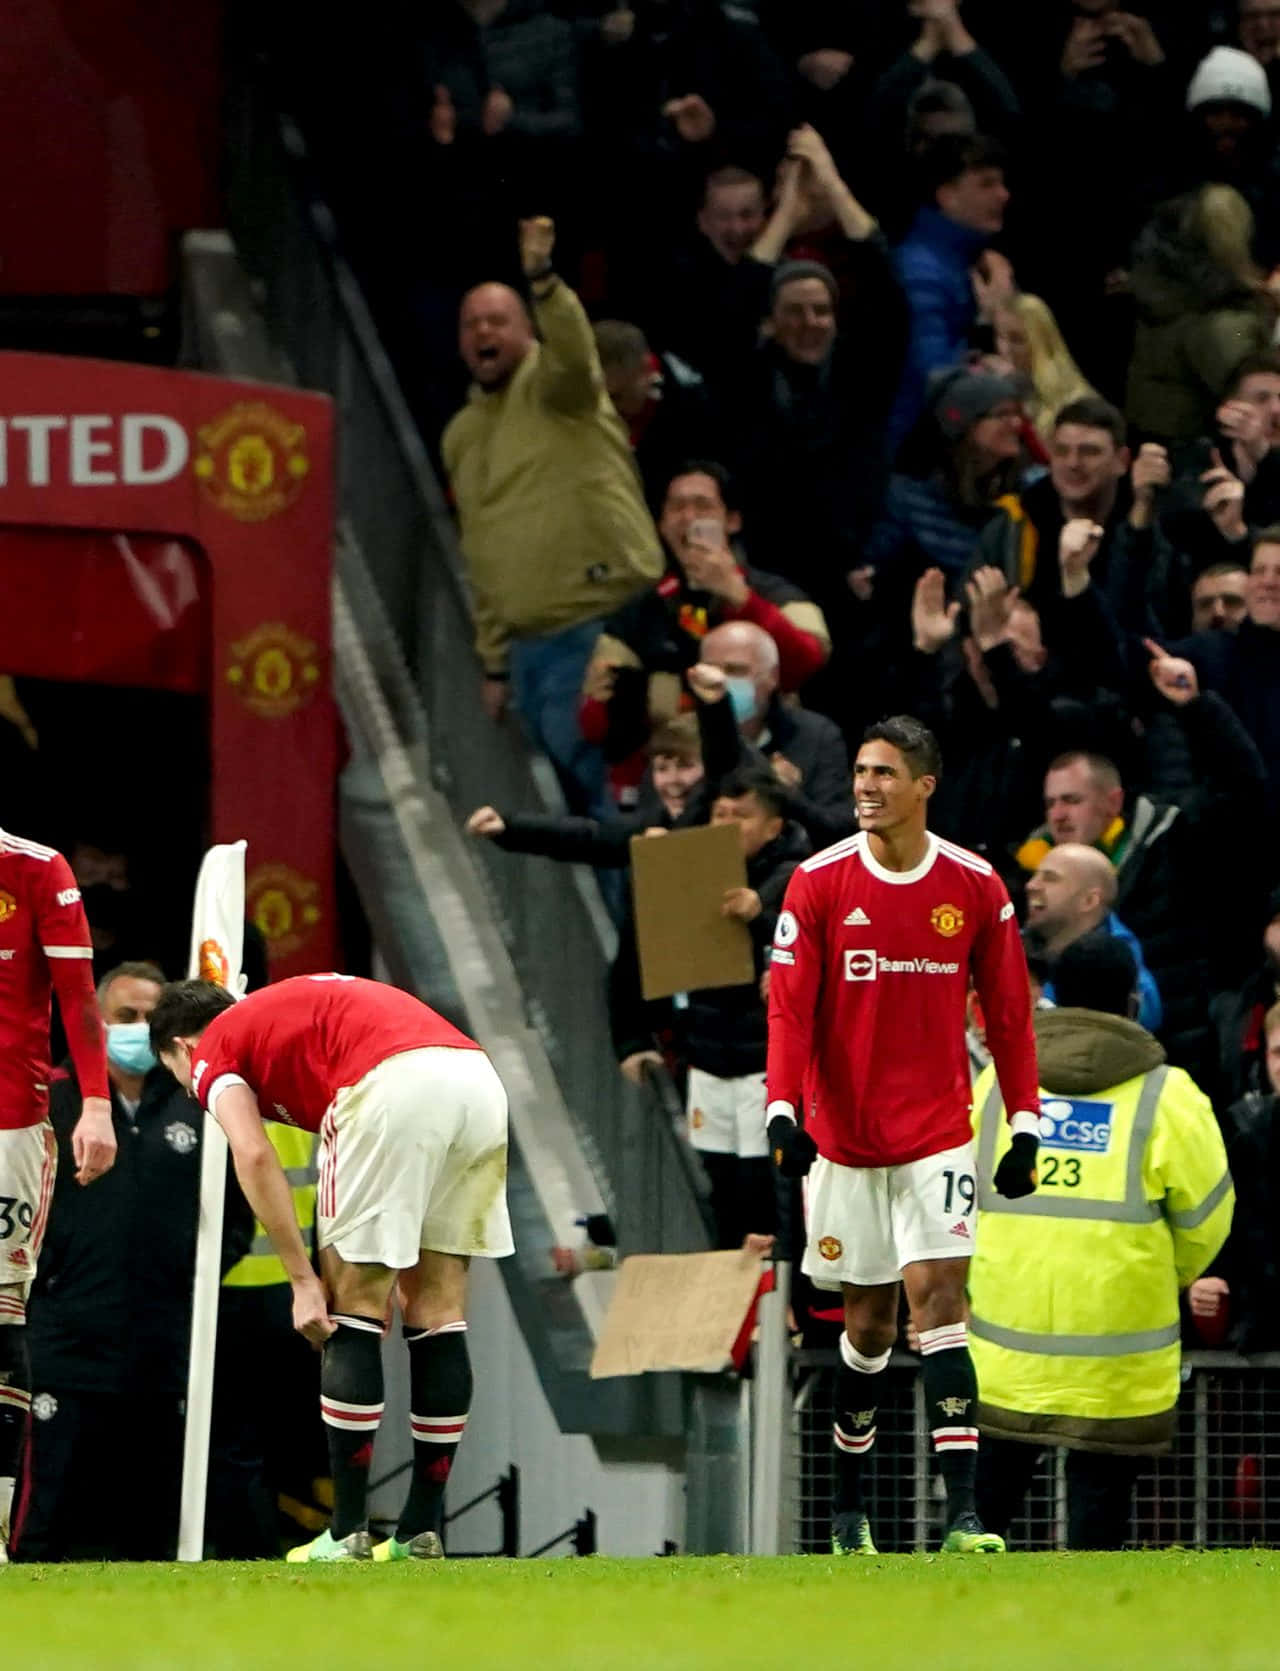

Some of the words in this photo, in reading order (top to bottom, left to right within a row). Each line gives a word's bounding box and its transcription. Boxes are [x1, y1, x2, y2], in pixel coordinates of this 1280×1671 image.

[878, 957, 959, 974] TeamViewer
[1061, 1121, 1111, 1143] CSG
[943, 1170, 976, 1216] 19
